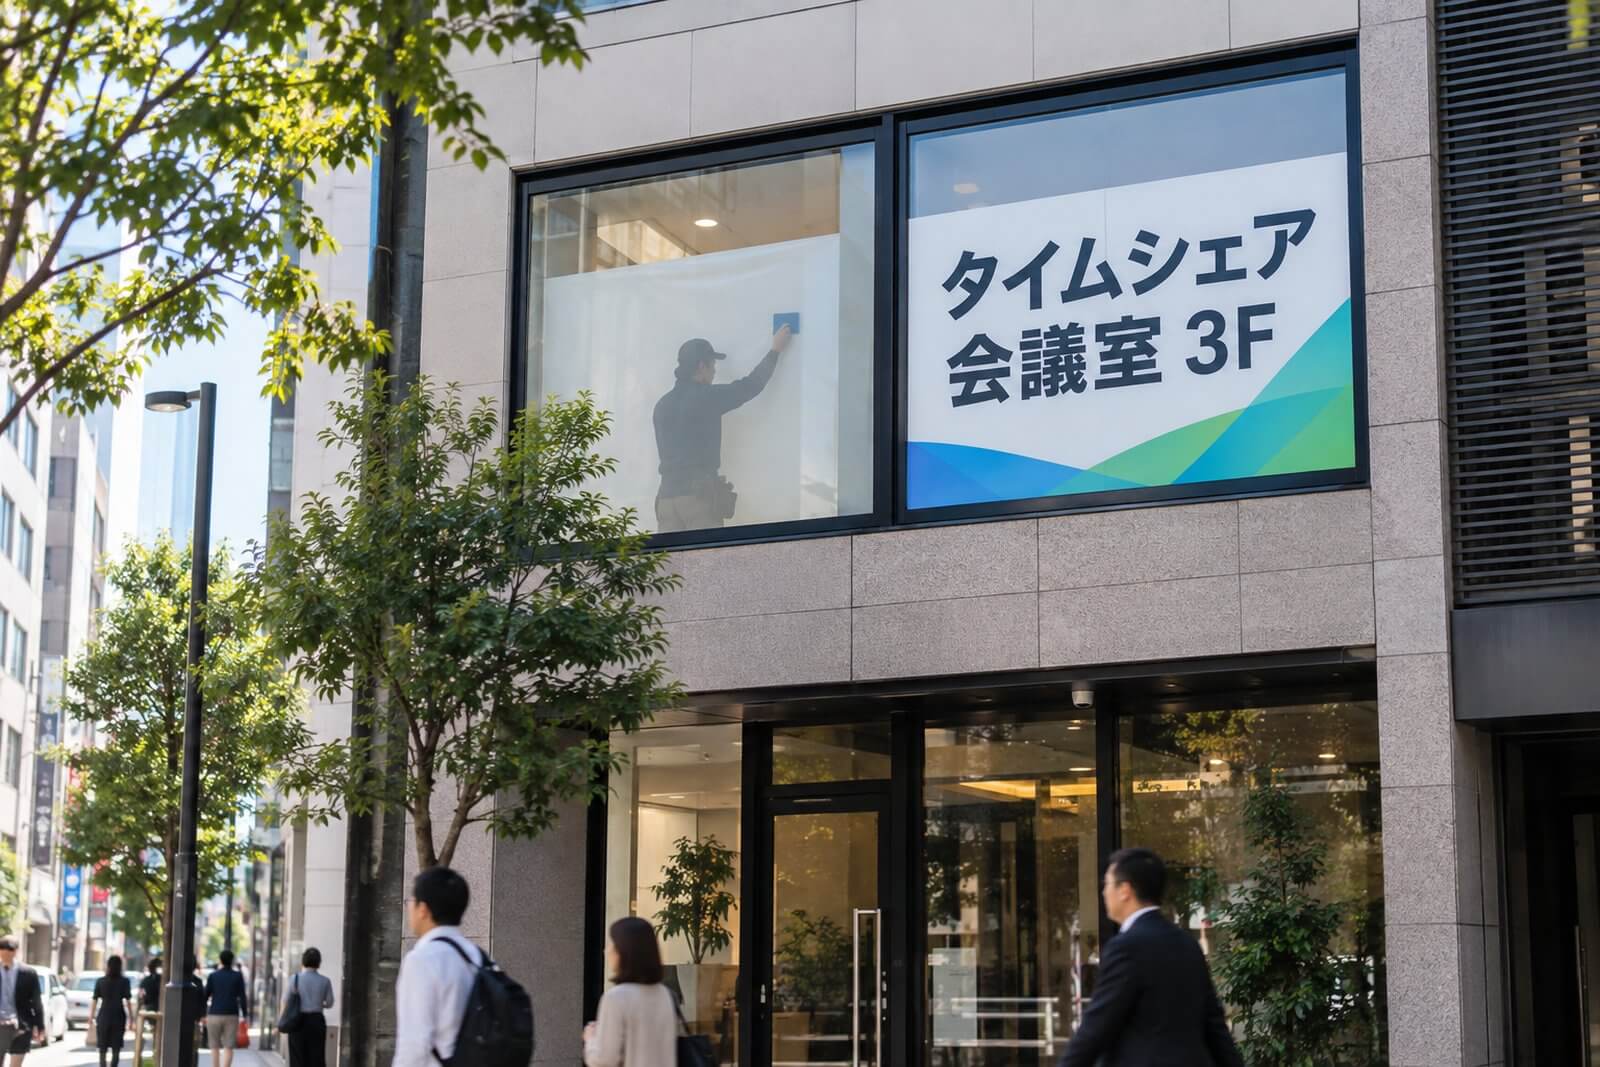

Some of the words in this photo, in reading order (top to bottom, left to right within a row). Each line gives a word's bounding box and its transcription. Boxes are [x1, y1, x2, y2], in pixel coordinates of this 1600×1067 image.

[942, 208, 1316, 320] タイムシェア
[946, 315, 1162, 408] 会議室
[1185, 302, 1276, 375] 3F
